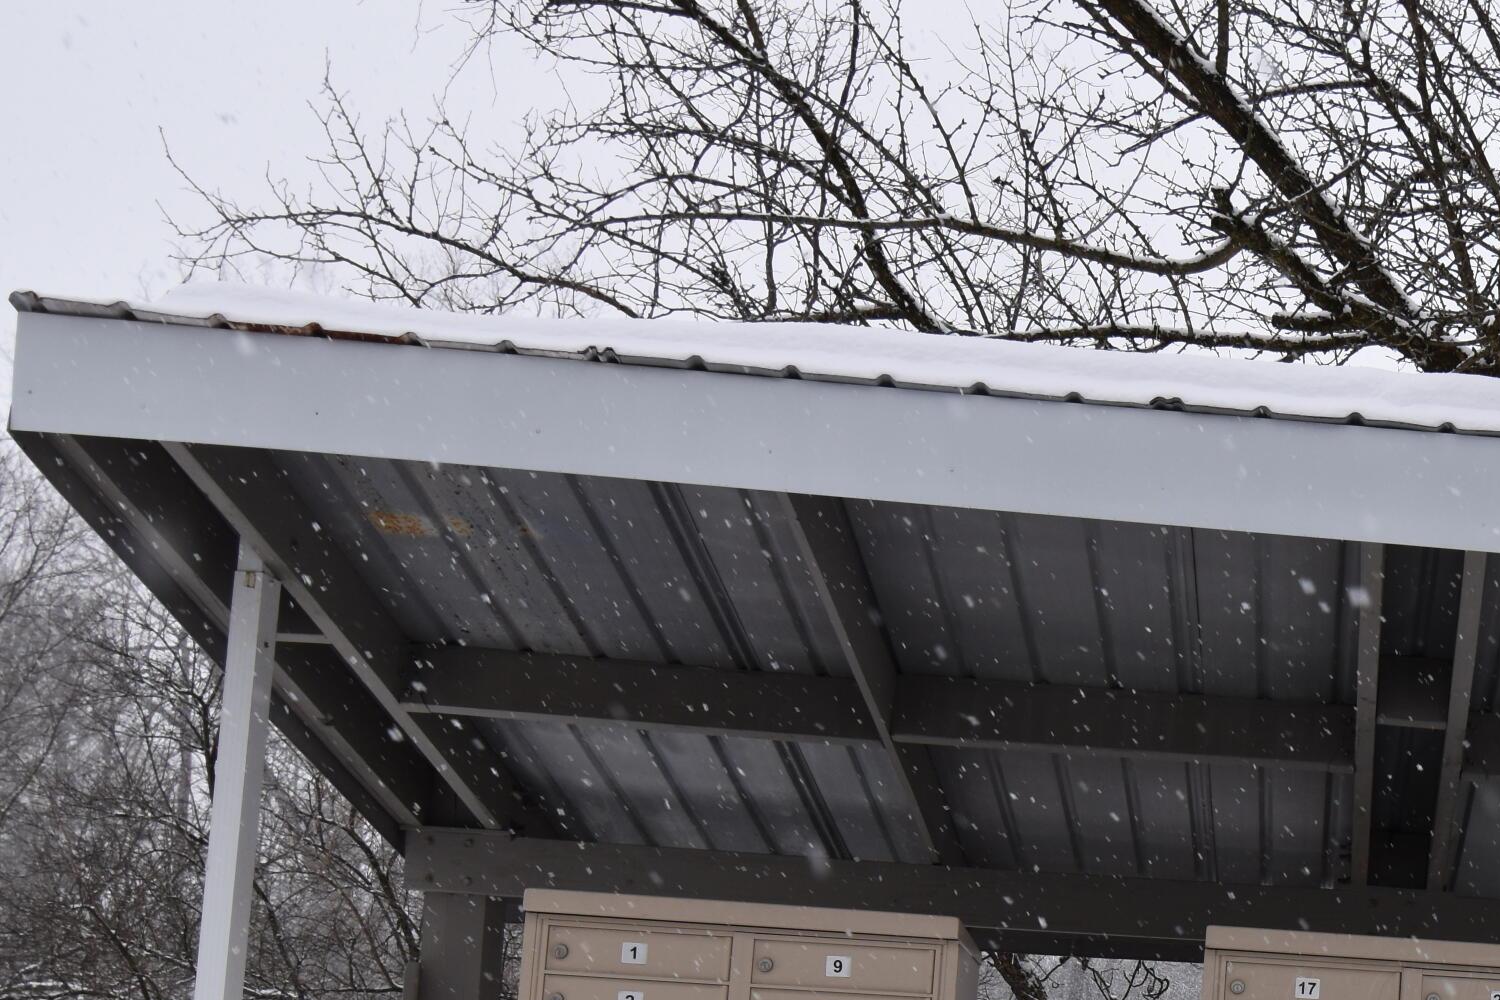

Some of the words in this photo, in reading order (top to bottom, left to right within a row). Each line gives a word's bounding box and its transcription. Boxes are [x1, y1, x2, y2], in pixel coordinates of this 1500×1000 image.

[630, 946, 637, 960] 1
[833, 959, 843, 974] 9
[1298, 981, 1317, 996] 17
